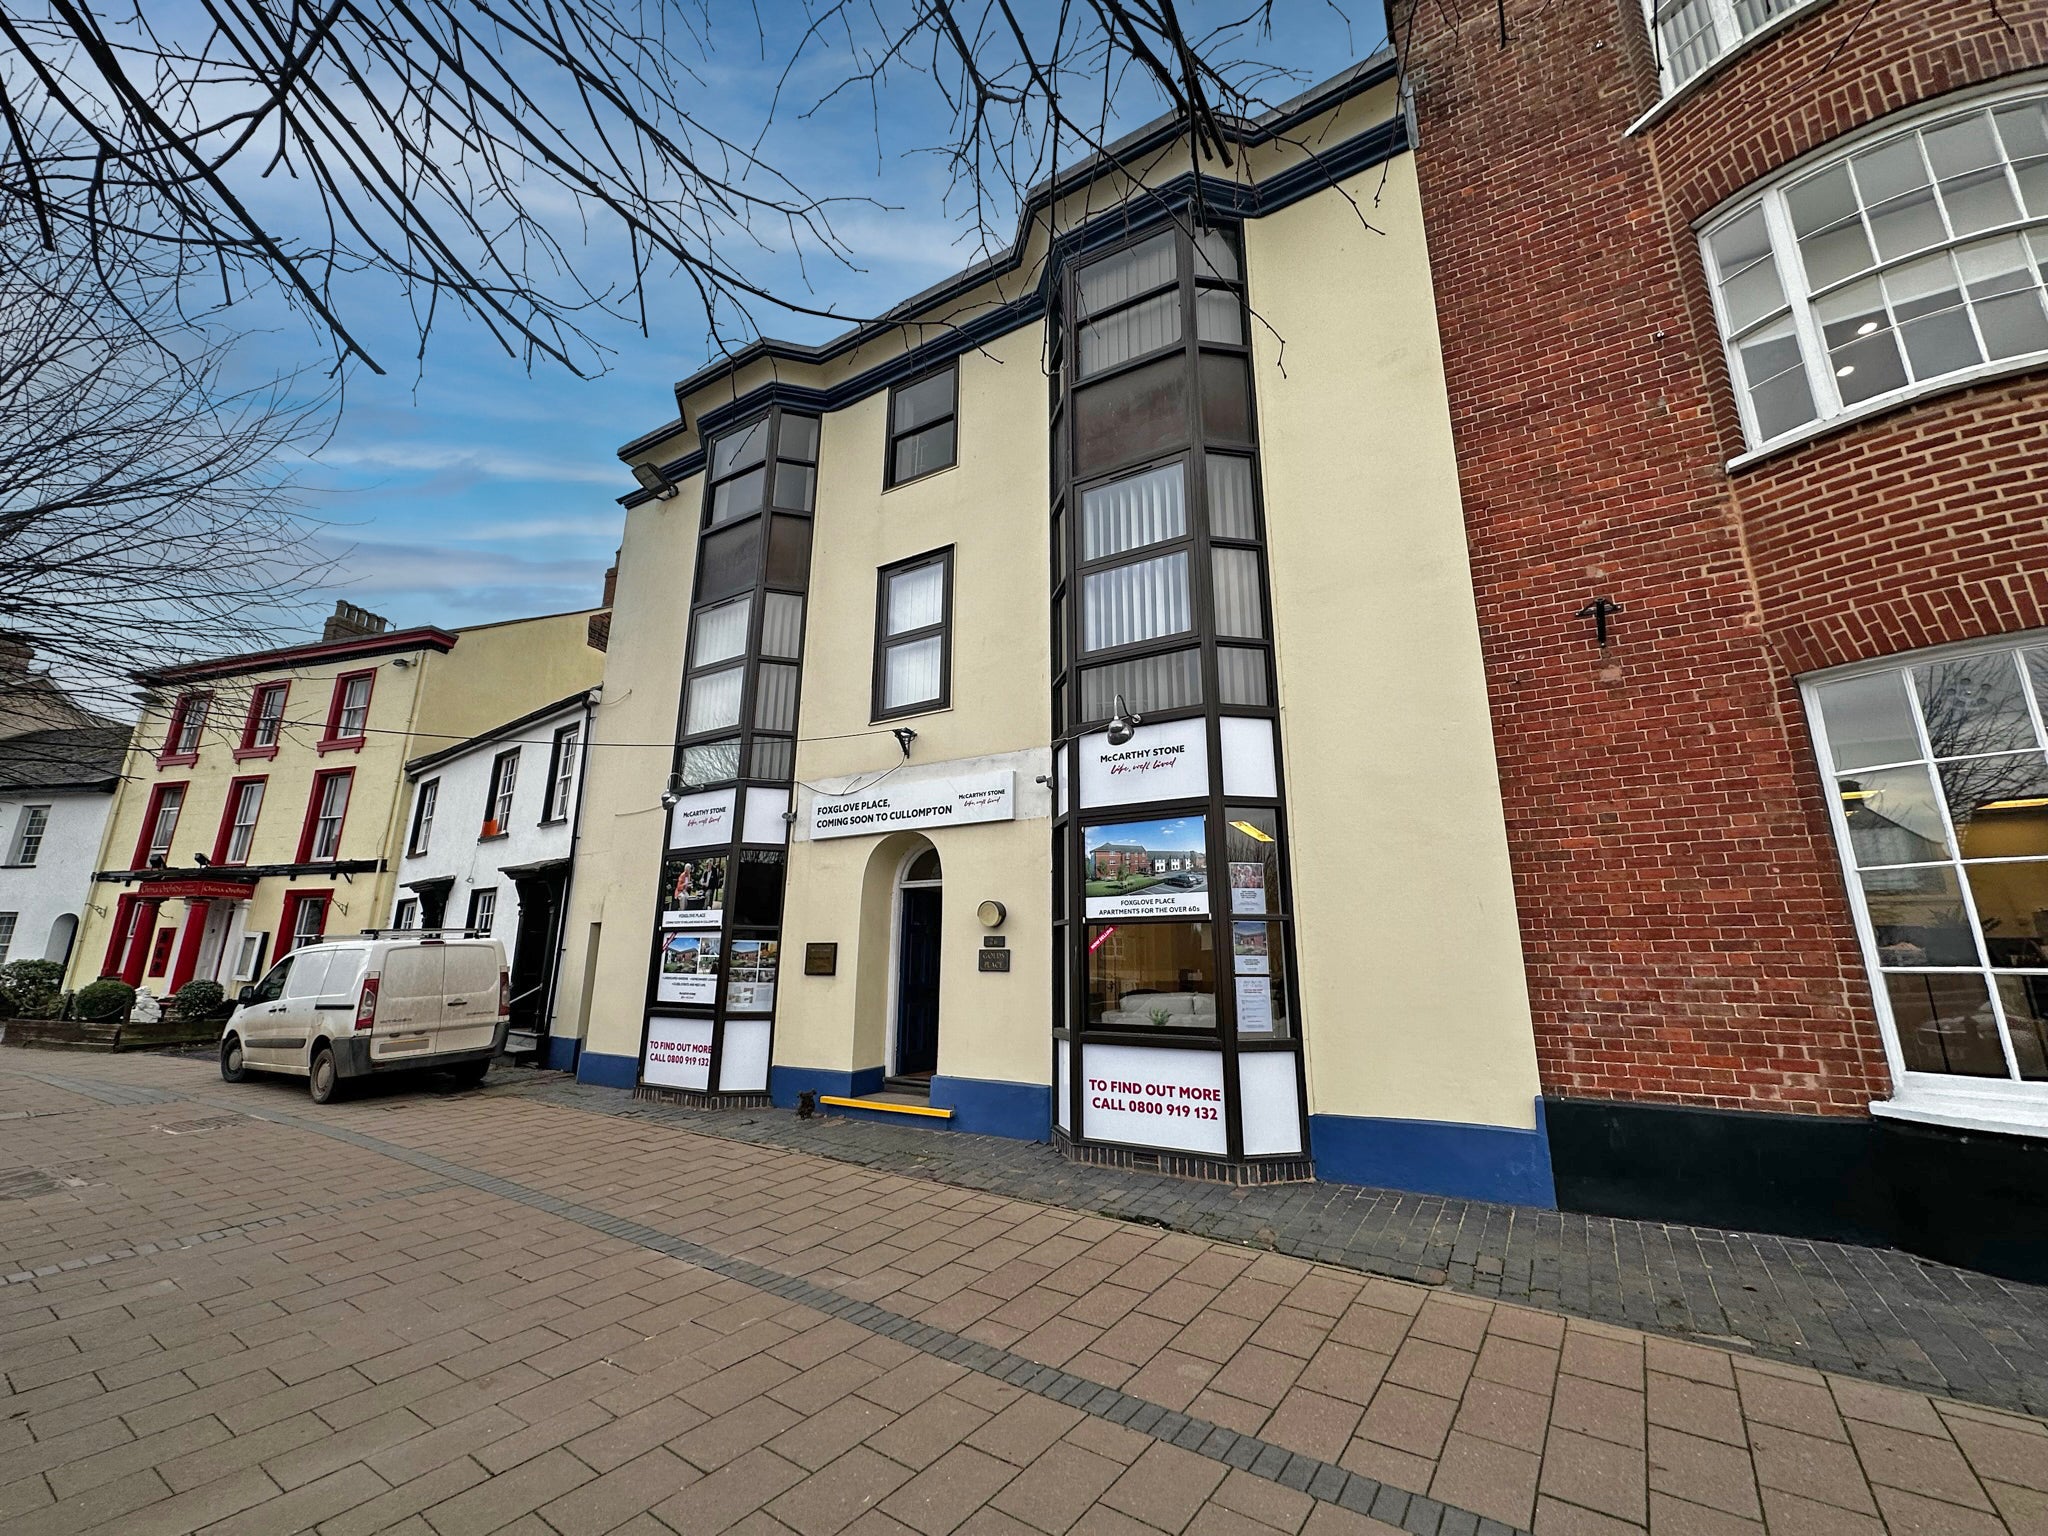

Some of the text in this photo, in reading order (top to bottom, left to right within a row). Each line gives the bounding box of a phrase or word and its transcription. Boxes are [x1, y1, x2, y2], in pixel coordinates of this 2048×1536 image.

[1100, 744, 1185, 763] McCARTHY STONE
[958, 788, 1005, 799] McCARTHY STONE
[683, 806, 727, 818] McCARTHY STONE
[817, 799, 891, 815] FOXGLOVE PLACE,
[816, 805, 952, 829] COMING SOON TO CULLOMPTON
[1154, 897, 1176, 905] PLACE
[650, 1041, 713, 1053] TO FIND OUT MORE
[650, 1053, 709, 1067] CALL 0800 919 132
[1089, 1079, 1221, 1101] TO FIND OUT MORE
[1092, 1097, 1218, 1120] CALL 0800 919 132
